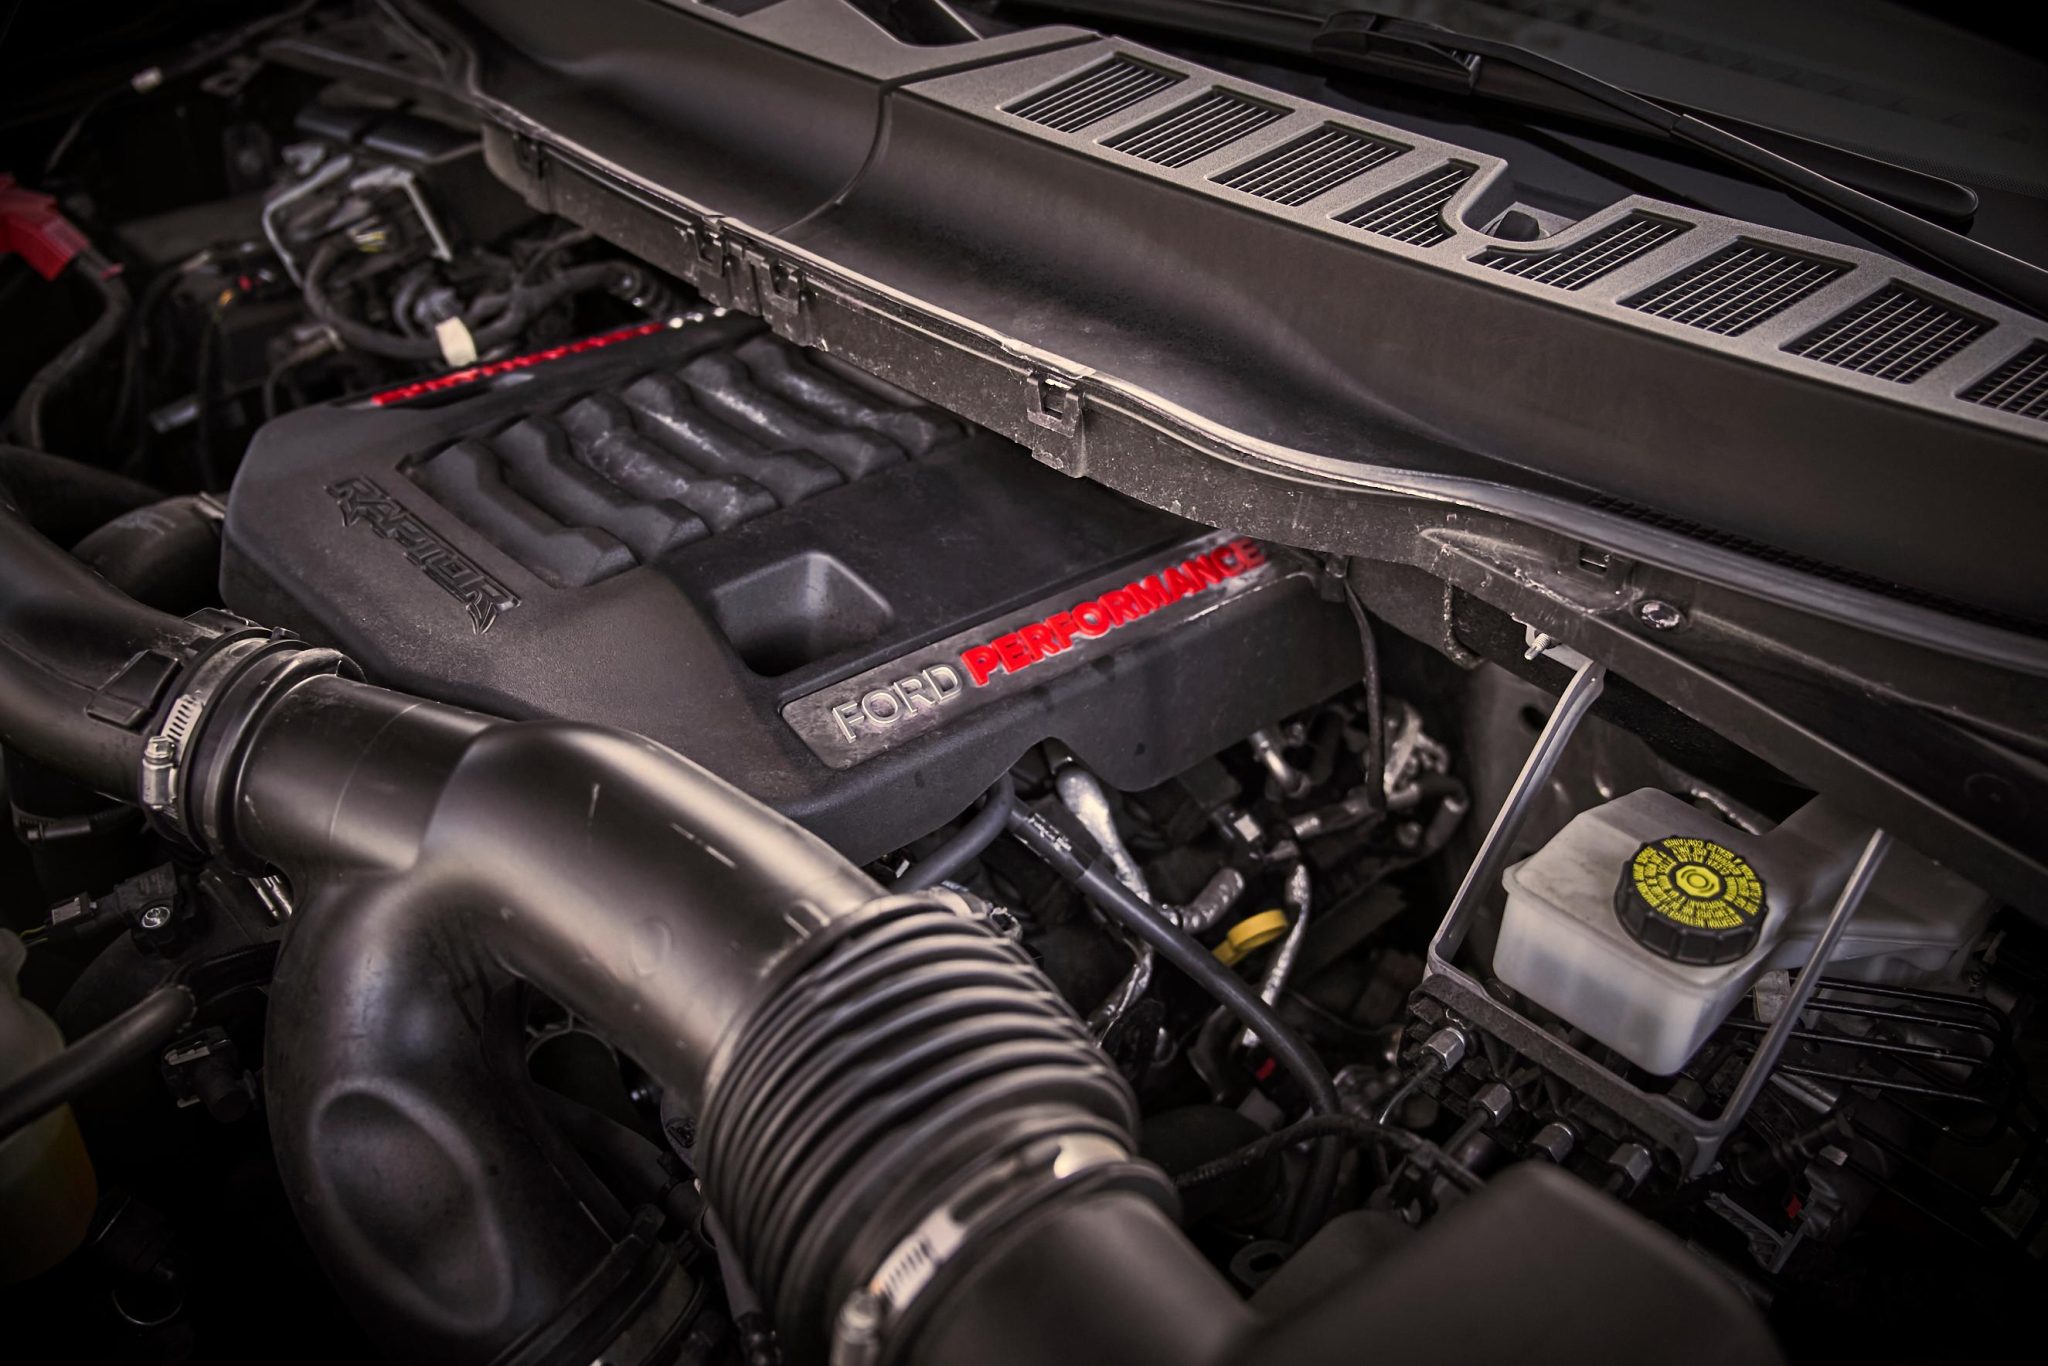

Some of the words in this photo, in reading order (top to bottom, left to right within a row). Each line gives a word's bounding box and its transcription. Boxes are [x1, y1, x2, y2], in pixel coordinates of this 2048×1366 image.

[324, 474, 522, 635] RAPTOR
[831, 664, 961, 743] FORD
[959, 537, 1266, 686] PERFORMANCE
[1663, 838, 1704, 848] CONTAINER
[1706, 842, 1734, 859] SEALED
